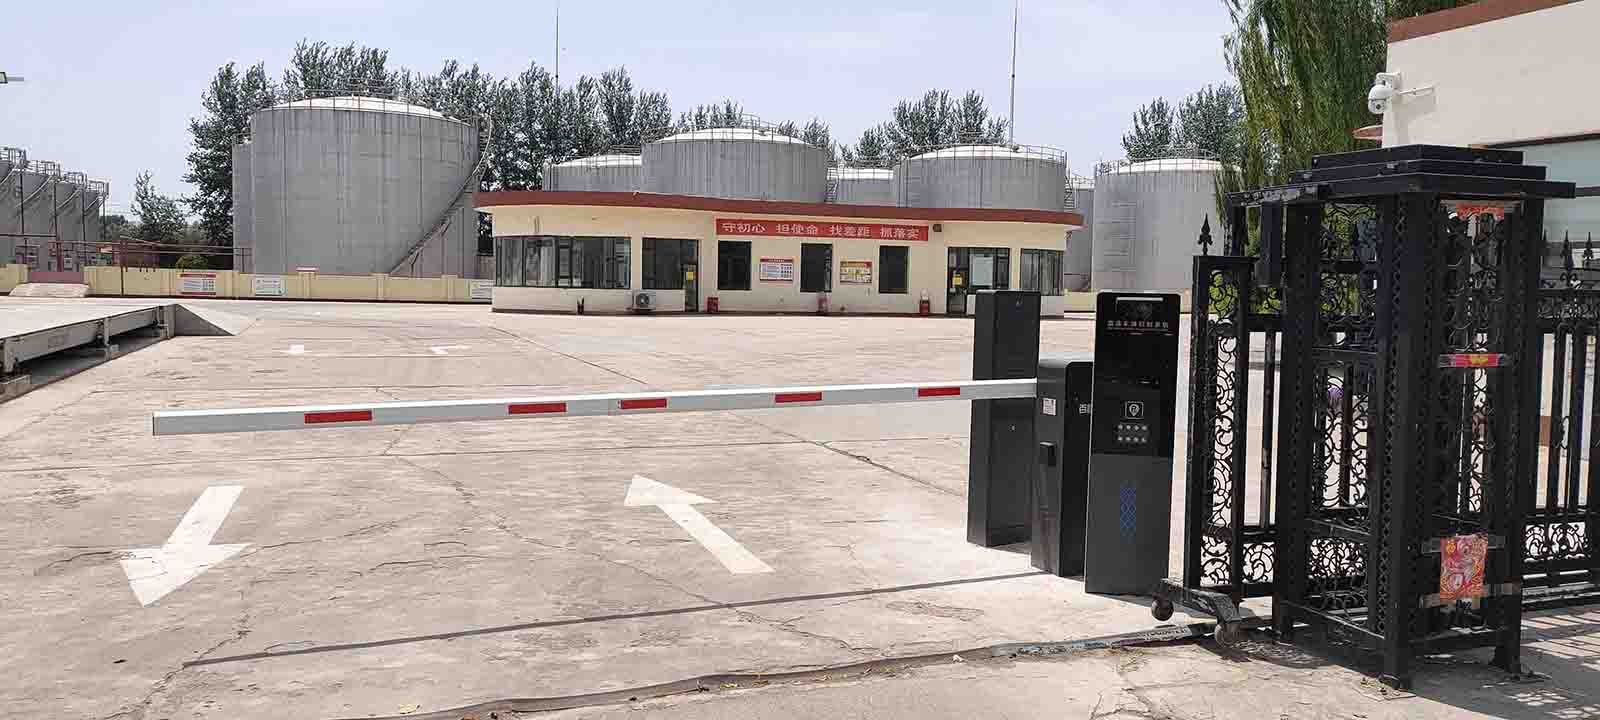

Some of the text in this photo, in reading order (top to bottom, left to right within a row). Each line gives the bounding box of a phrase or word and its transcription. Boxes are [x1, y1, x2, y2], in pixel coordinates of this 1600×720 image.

[721, 222, 920, 239] 守初心 担使命 找差距 抓落实
